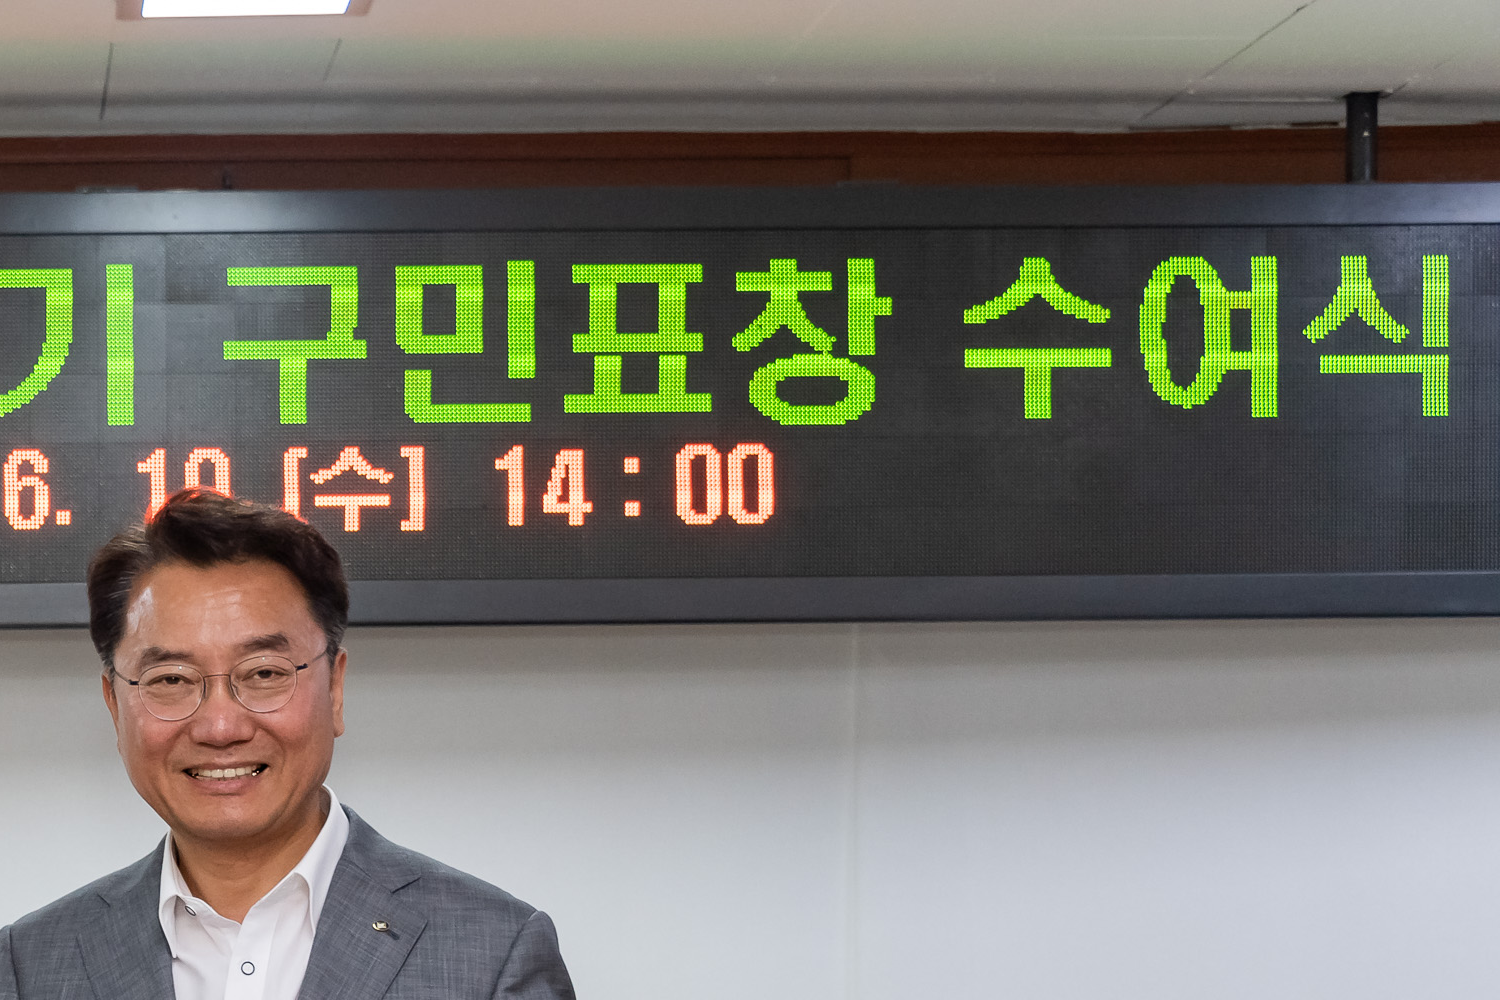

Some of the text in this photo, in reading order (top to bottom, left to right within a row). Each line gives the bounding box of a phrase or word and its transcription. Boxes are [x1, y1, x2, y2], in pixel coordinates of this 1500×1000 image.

[223, 259, 892, 425] 구민표창
[964, 255, 1449, 419] 수여식
[2, 448, 71, 530] 6.
[282, 445, 426, 532] [수]
